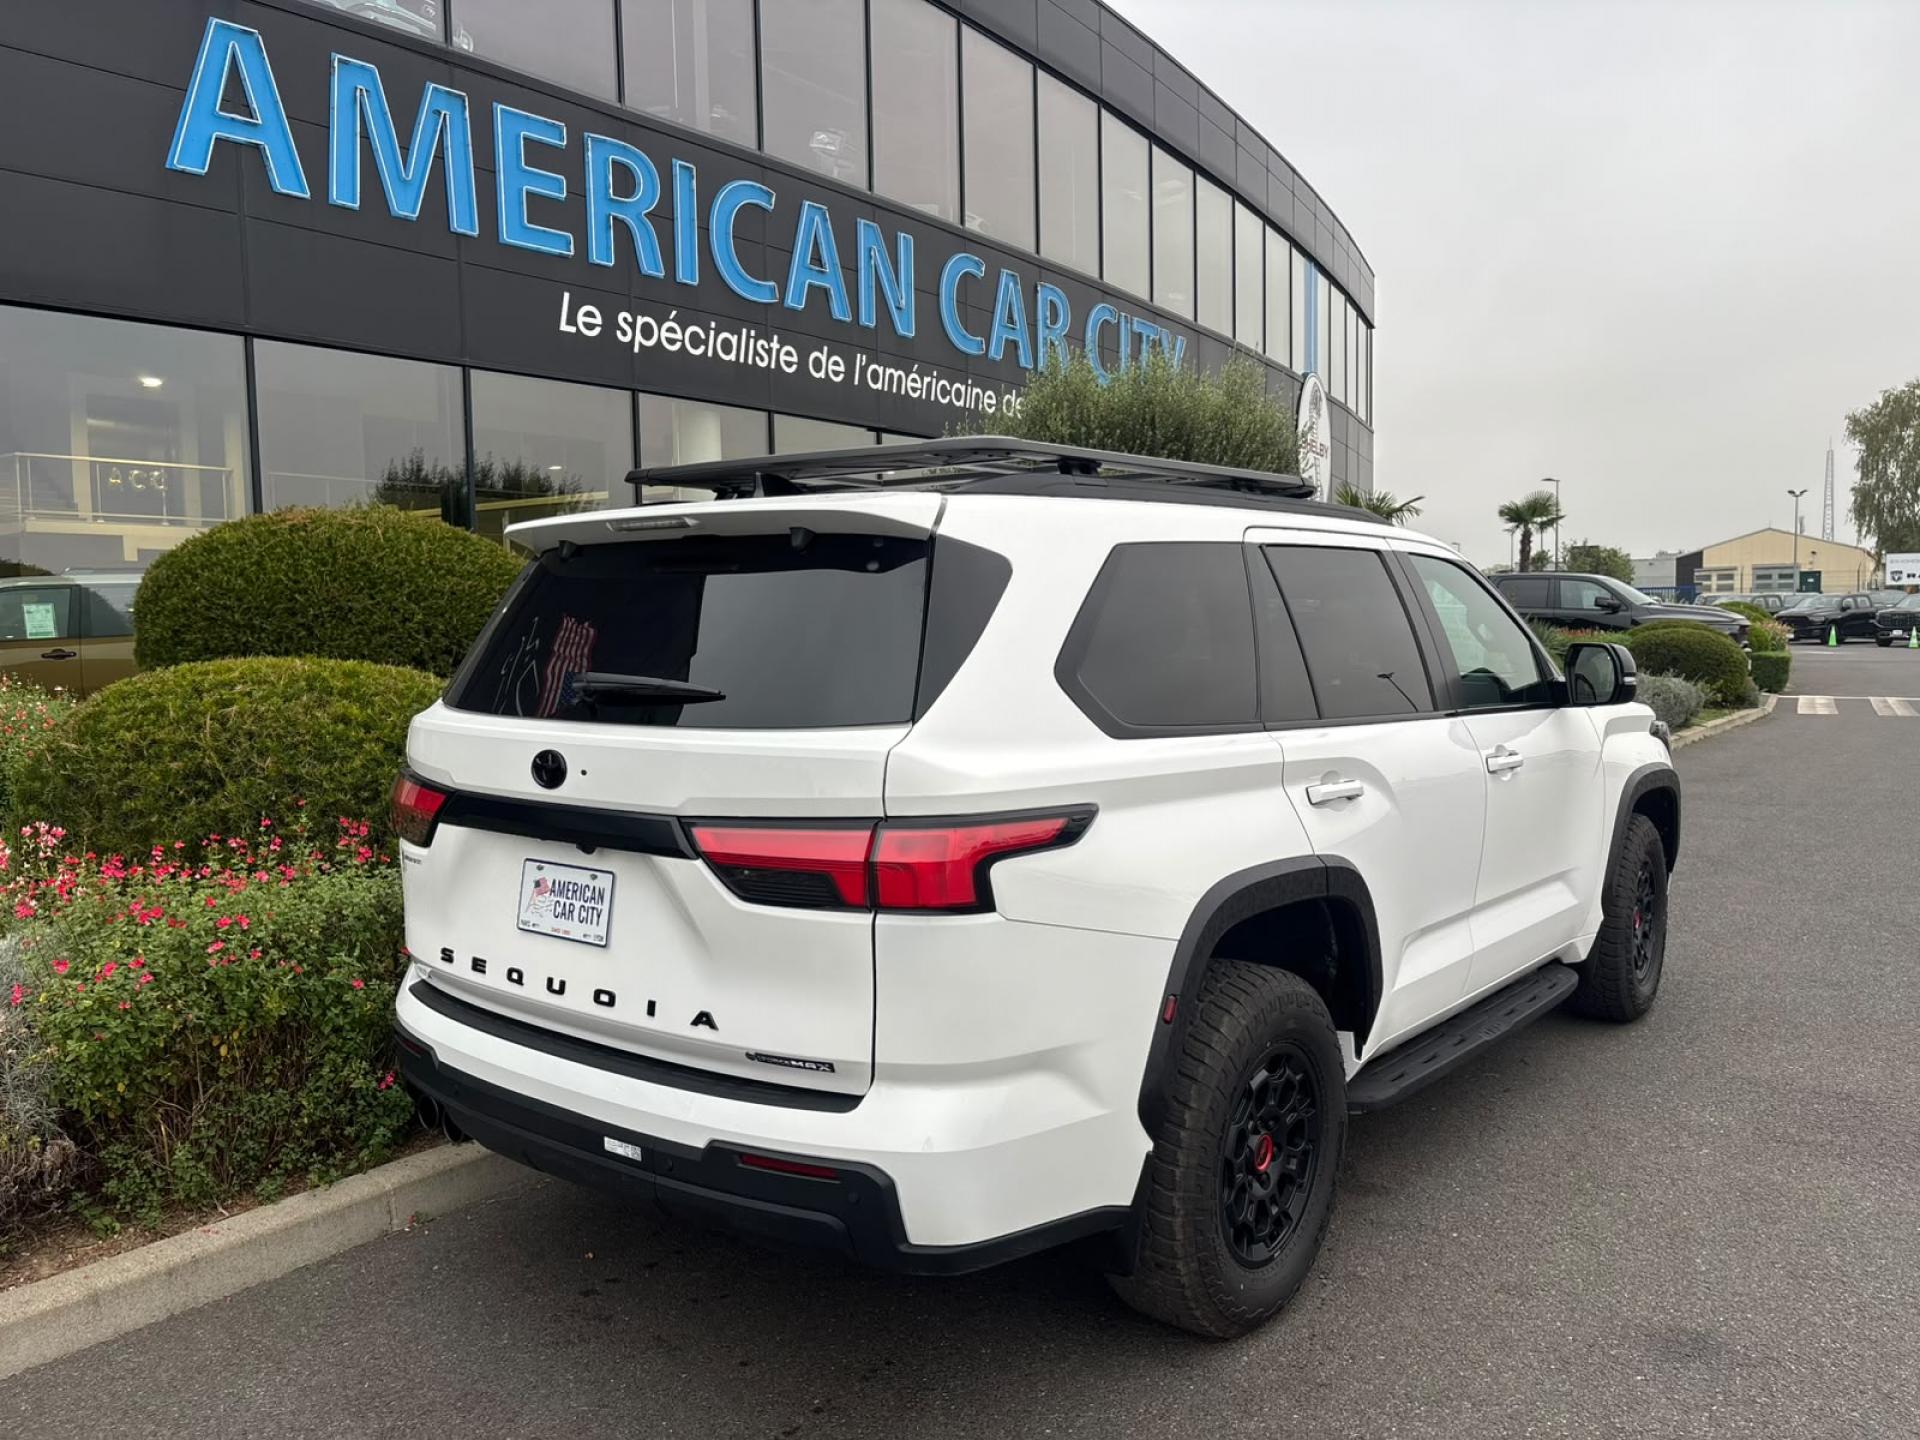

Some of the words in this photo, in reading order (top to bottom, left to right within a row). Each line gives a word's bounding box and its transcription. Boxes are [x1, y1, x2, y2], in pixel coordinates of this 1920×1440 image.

[165, 16, 916, 338] AMERICAN
[939, 253, 1072, 374] CAR
[559, 291, 602, 337] Le
[616, 309, 799, 374] spécialiste
[808, 345, 845, 382] de
[549, 878, 605, 906] AMERICAN
[553, 900, 576, 922] CAR
[578, 904, 603, 927] CITY
[440, 946, 719, 1031] SEQUOIA
